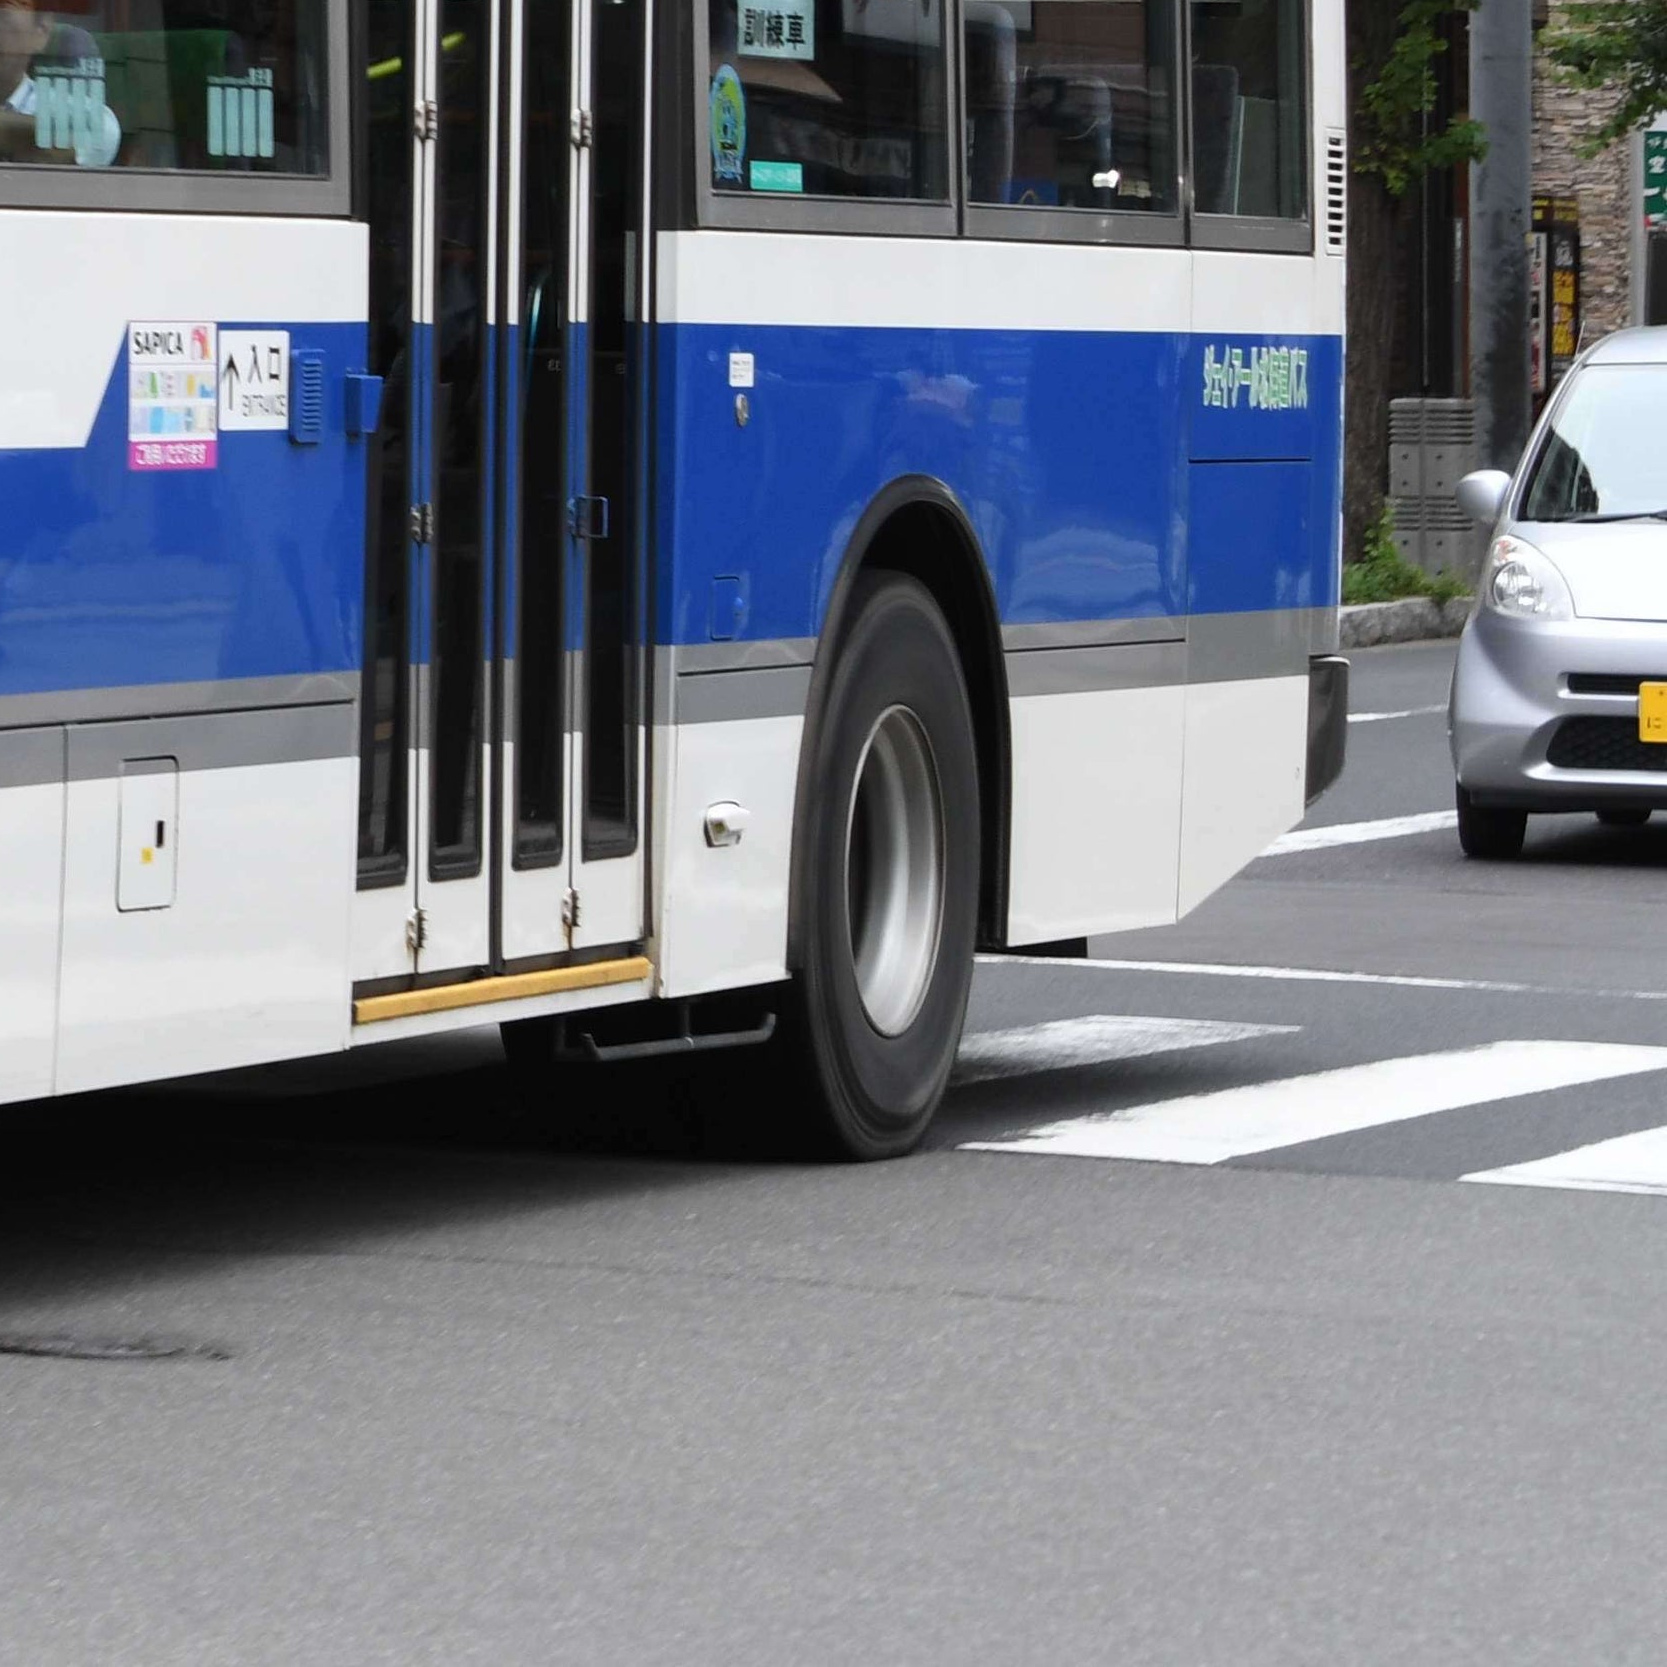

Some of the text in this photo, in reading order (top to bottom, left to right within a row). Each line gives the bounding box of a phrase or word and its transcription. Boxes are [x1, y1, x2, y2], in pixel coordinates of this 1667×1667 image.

[744, 7, 806, 51] 訓練車
[134, 331, 184, 356] SAPICA
[248, 343, 281, 384] 入口
